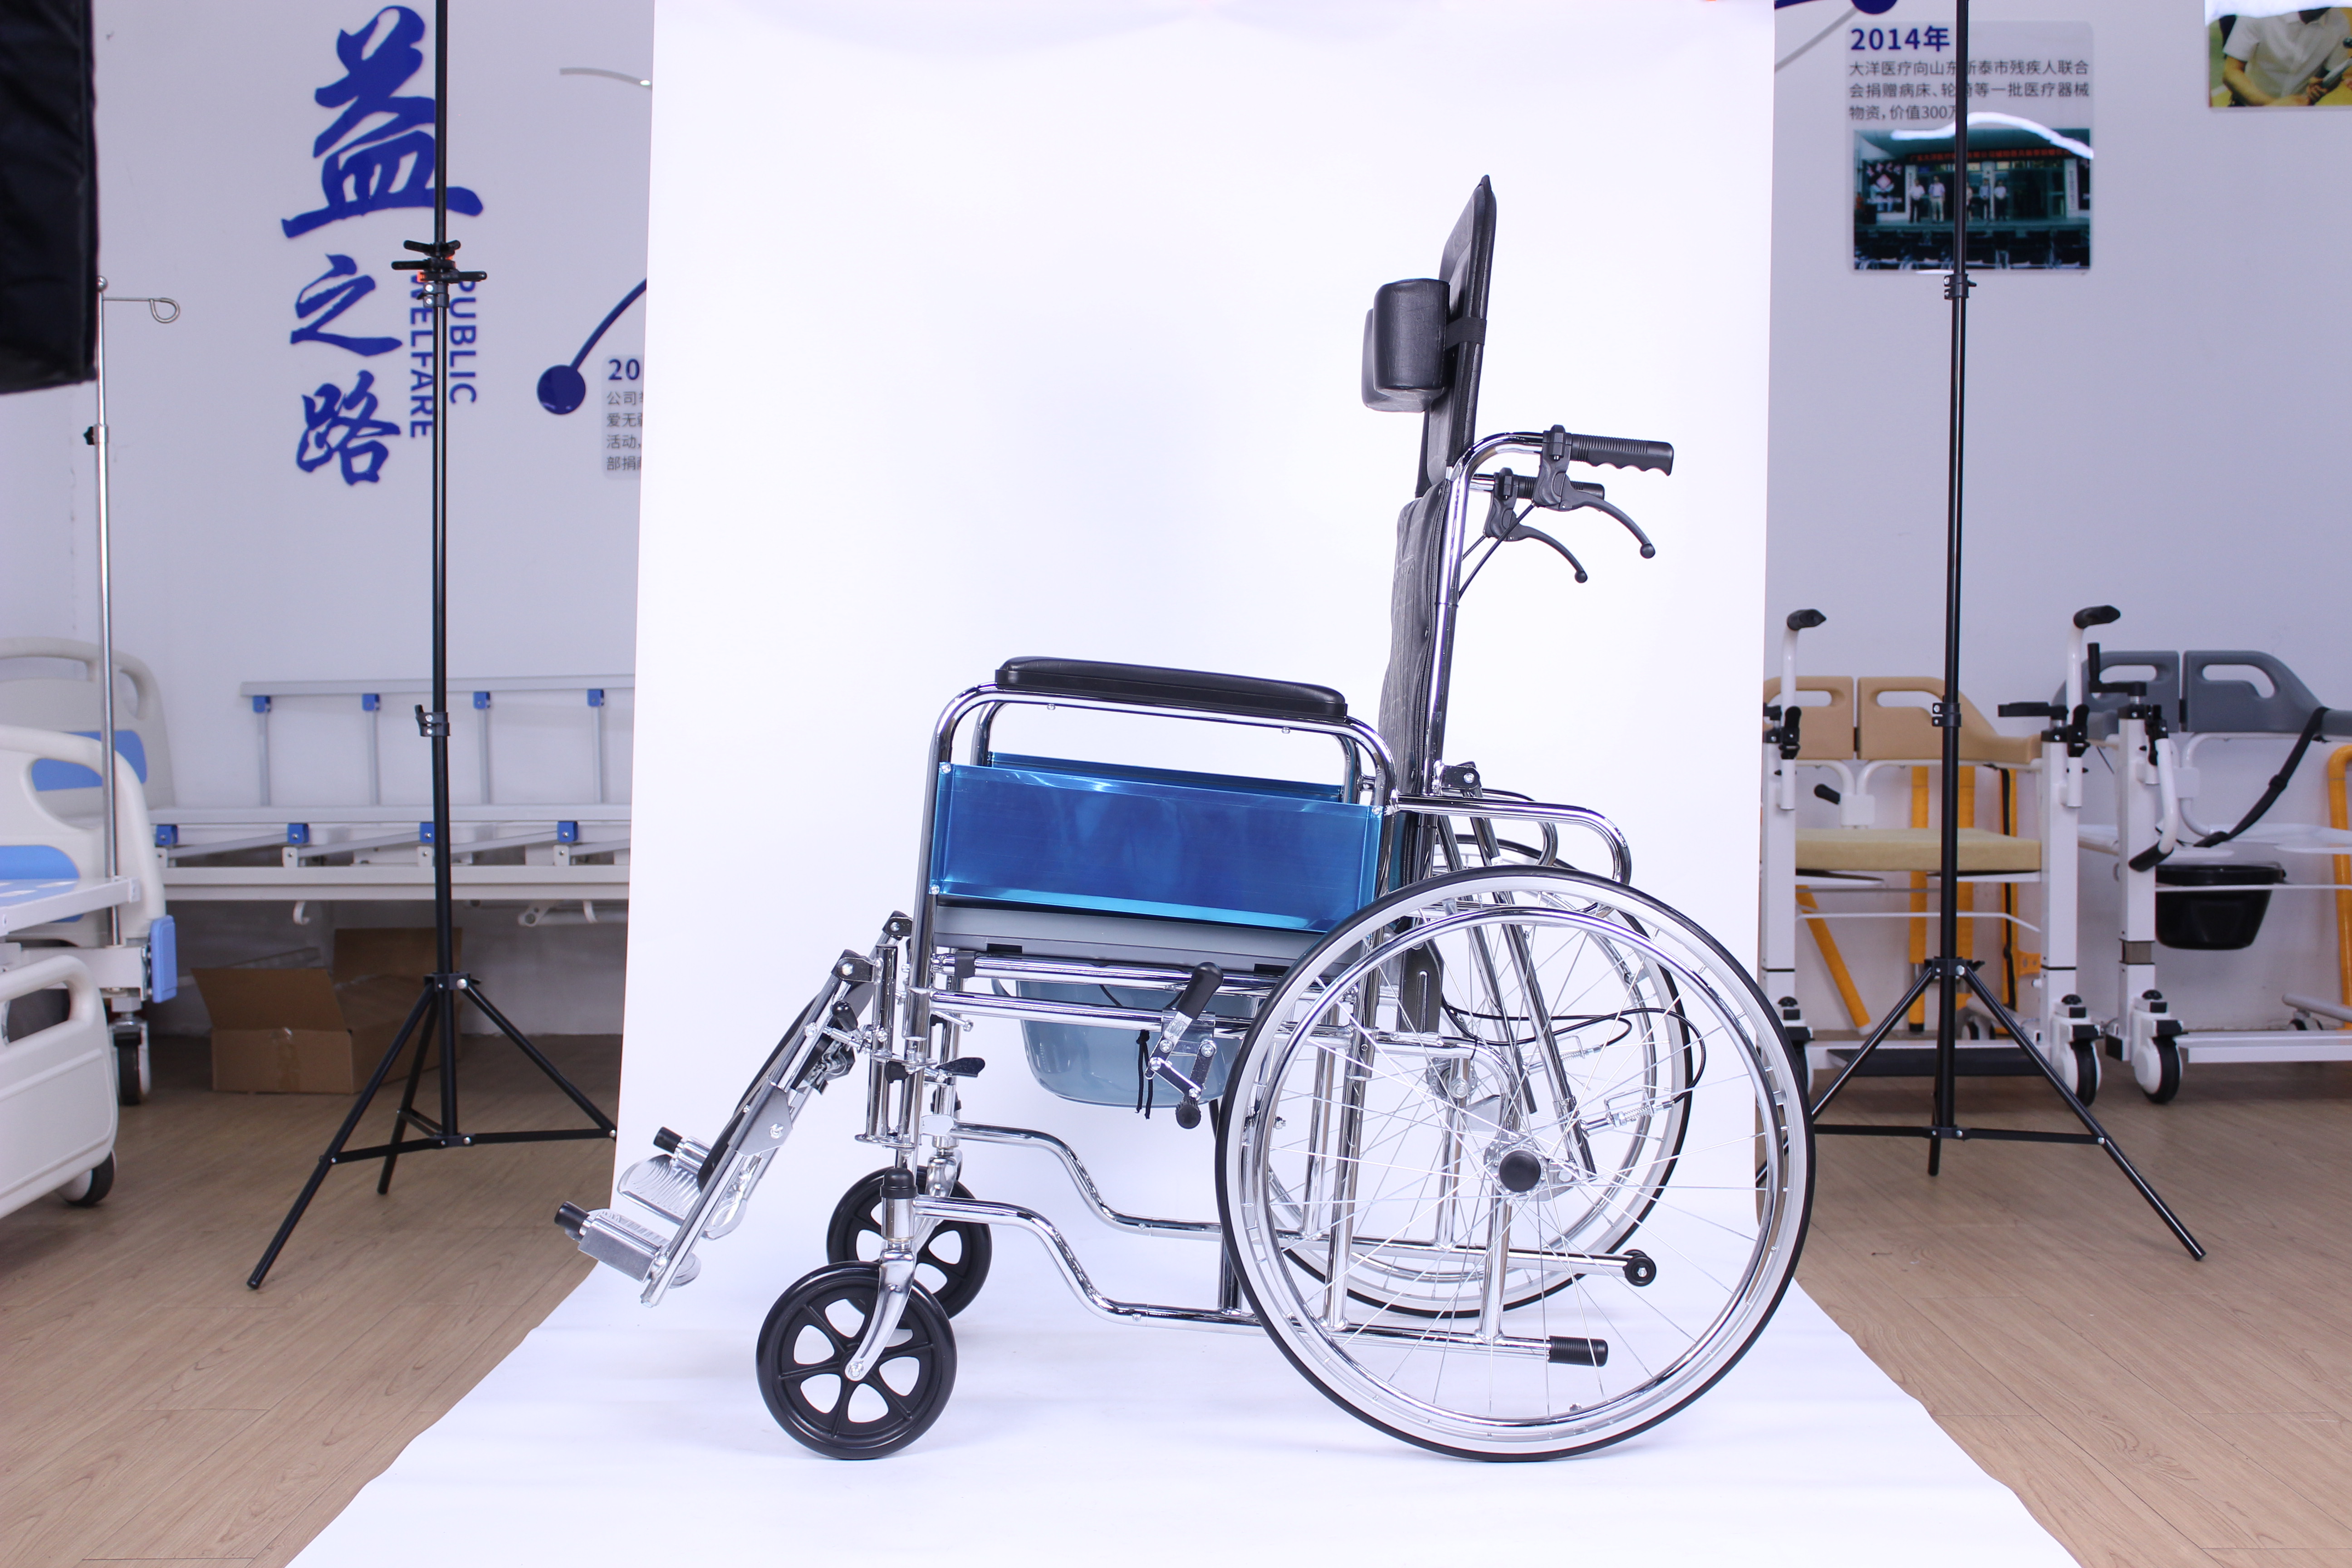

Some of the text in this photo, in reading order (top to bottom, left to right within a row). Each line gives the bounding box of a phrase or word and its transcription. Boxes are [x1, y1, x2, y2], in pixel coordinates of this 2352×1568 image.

[1851, 24, 1950, 52] 2014年
[281, 5, 483, 486] 益之路
[607, 391, 643, 406] 公司
